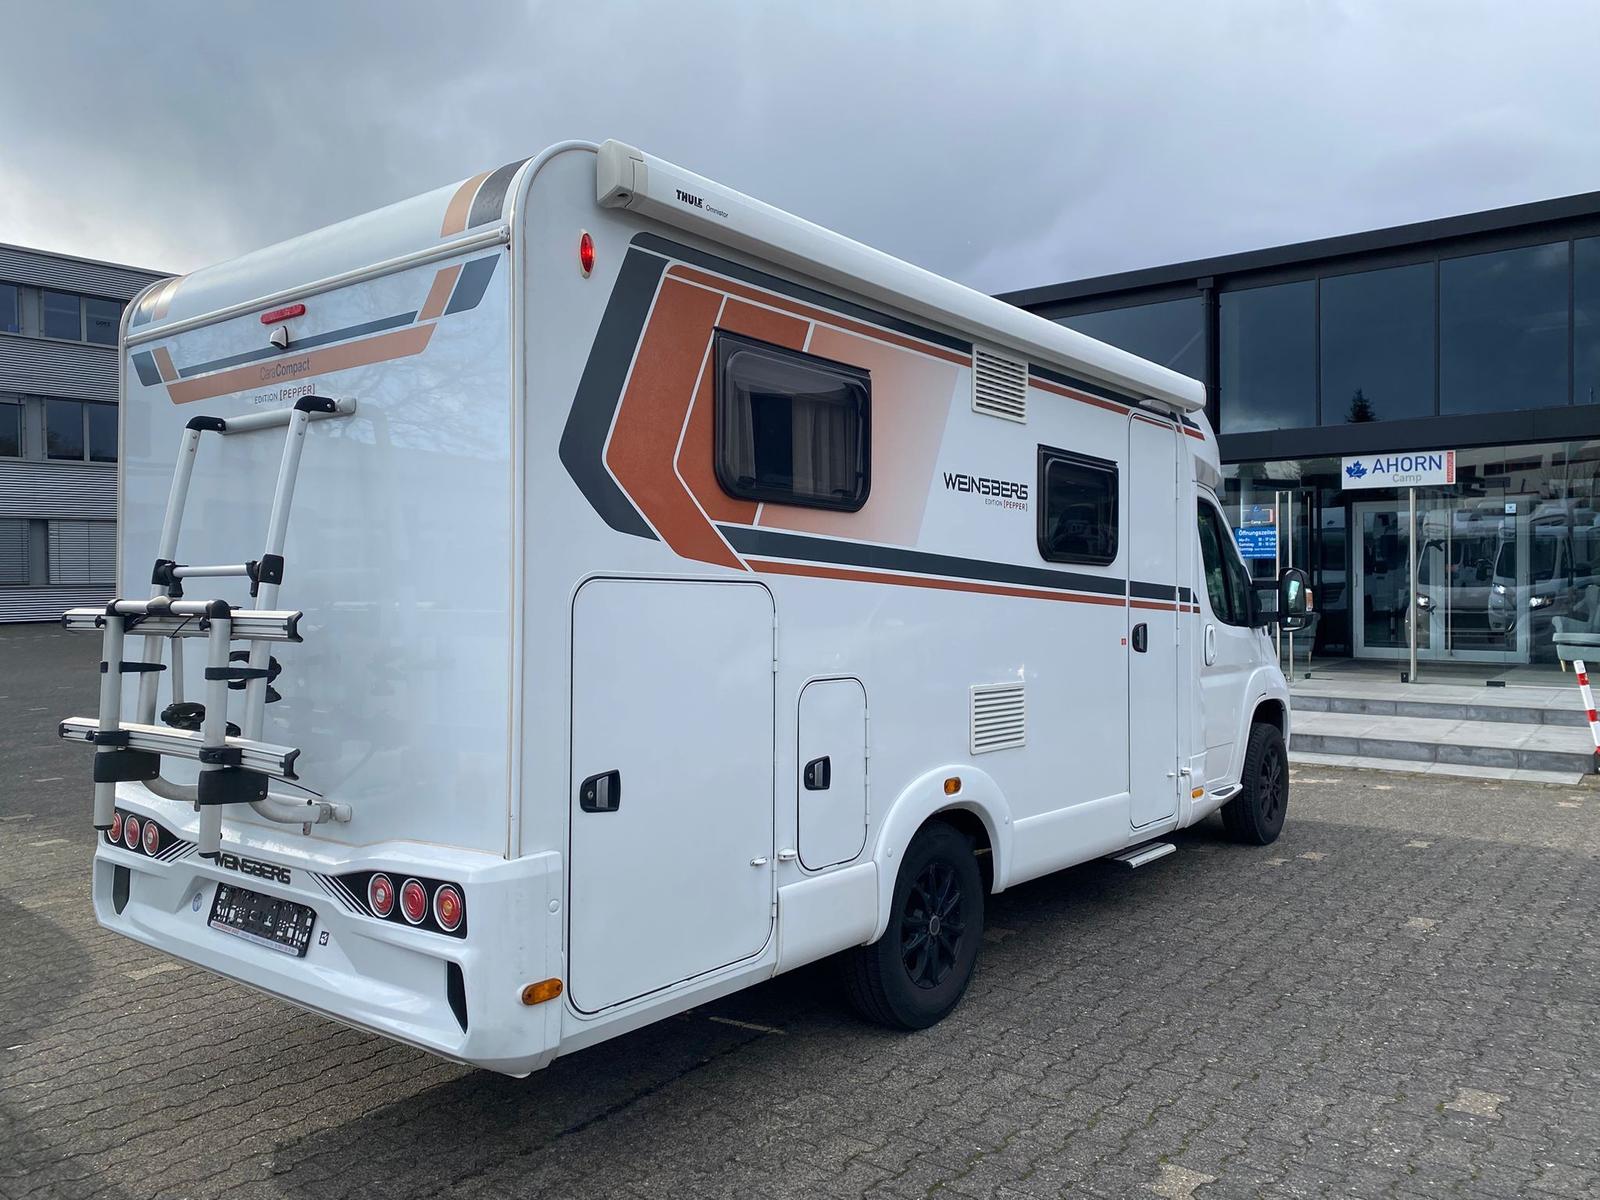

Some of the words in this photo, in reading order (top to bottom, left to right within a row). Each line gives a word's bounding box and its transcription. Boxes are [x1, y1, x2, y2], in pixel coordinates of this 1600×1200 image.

[676, 189, 703, 206] THULE
[260, 357, 310, 381] CaraCompact
[254, 393, 278, 404] EDITION
[279, 383, 316, 401] [PEPPER]
[1372, 455, 1442, 474] AHORN
[943, 472, 1028, 500] WEINSBERG
[1392, 474, 1422, 484] Camp
[1003, 500, 1028, 512] [PEPPER]
